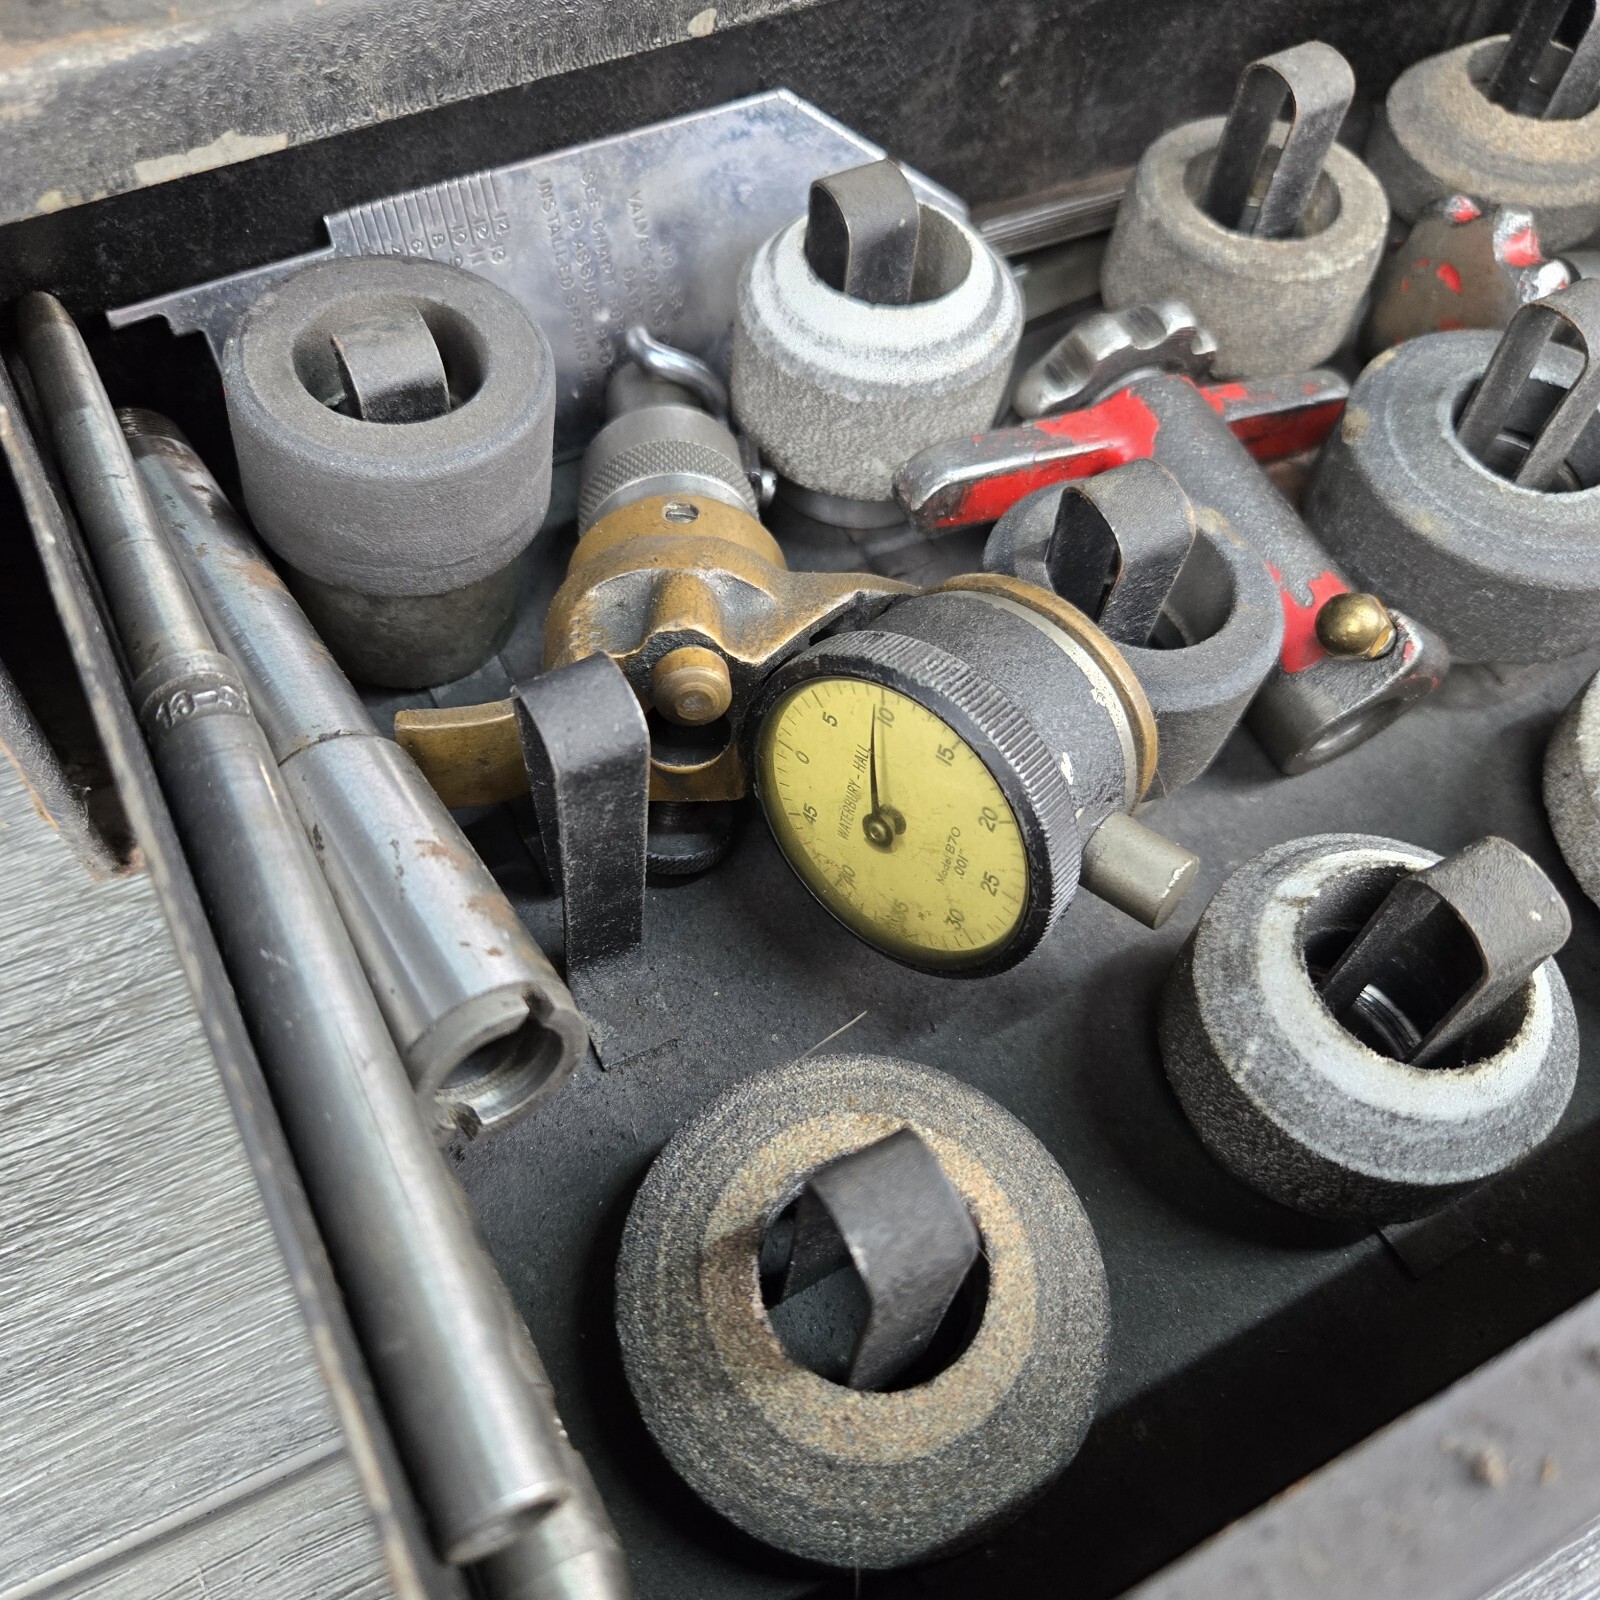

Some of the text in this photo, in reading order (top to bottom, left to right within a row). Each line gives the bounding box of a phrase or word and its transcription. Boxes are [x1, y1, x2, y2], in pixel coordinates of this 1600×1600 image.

[472, 219, 490, 240] 12
[493, 212, 510, 235] 14
[566, 208, 584, 232] TO
[581, 170, 601, 210] SEE
[591, 220, 617, 286] CHART
[409, 238, 424, 255] 6
[450, 224, 467, 246] 10
[536, 178, 575, 291] INSTALLED
[565, 294, 591, 361] SPRING
[627, 190, 666, 328] VALVE SPRING
[573, 241, 604, 319] ASSURE
[823, 712, 838, 727] 5
[877, 707, 895, 728] 10
[797, 750, 810, 765] 0
[936, 744, 955, 767] 15
[836, 778, 863, 840] WATERBURY
[854, 744, 872, 775] HALL
[805, 802, 818, 825] 45
[978, 807, 998, 833] 20
[937, 827, 962, 886] Model B70
[980, 871, 1000, 898] 25
[946, 909, 964, 931] 30
